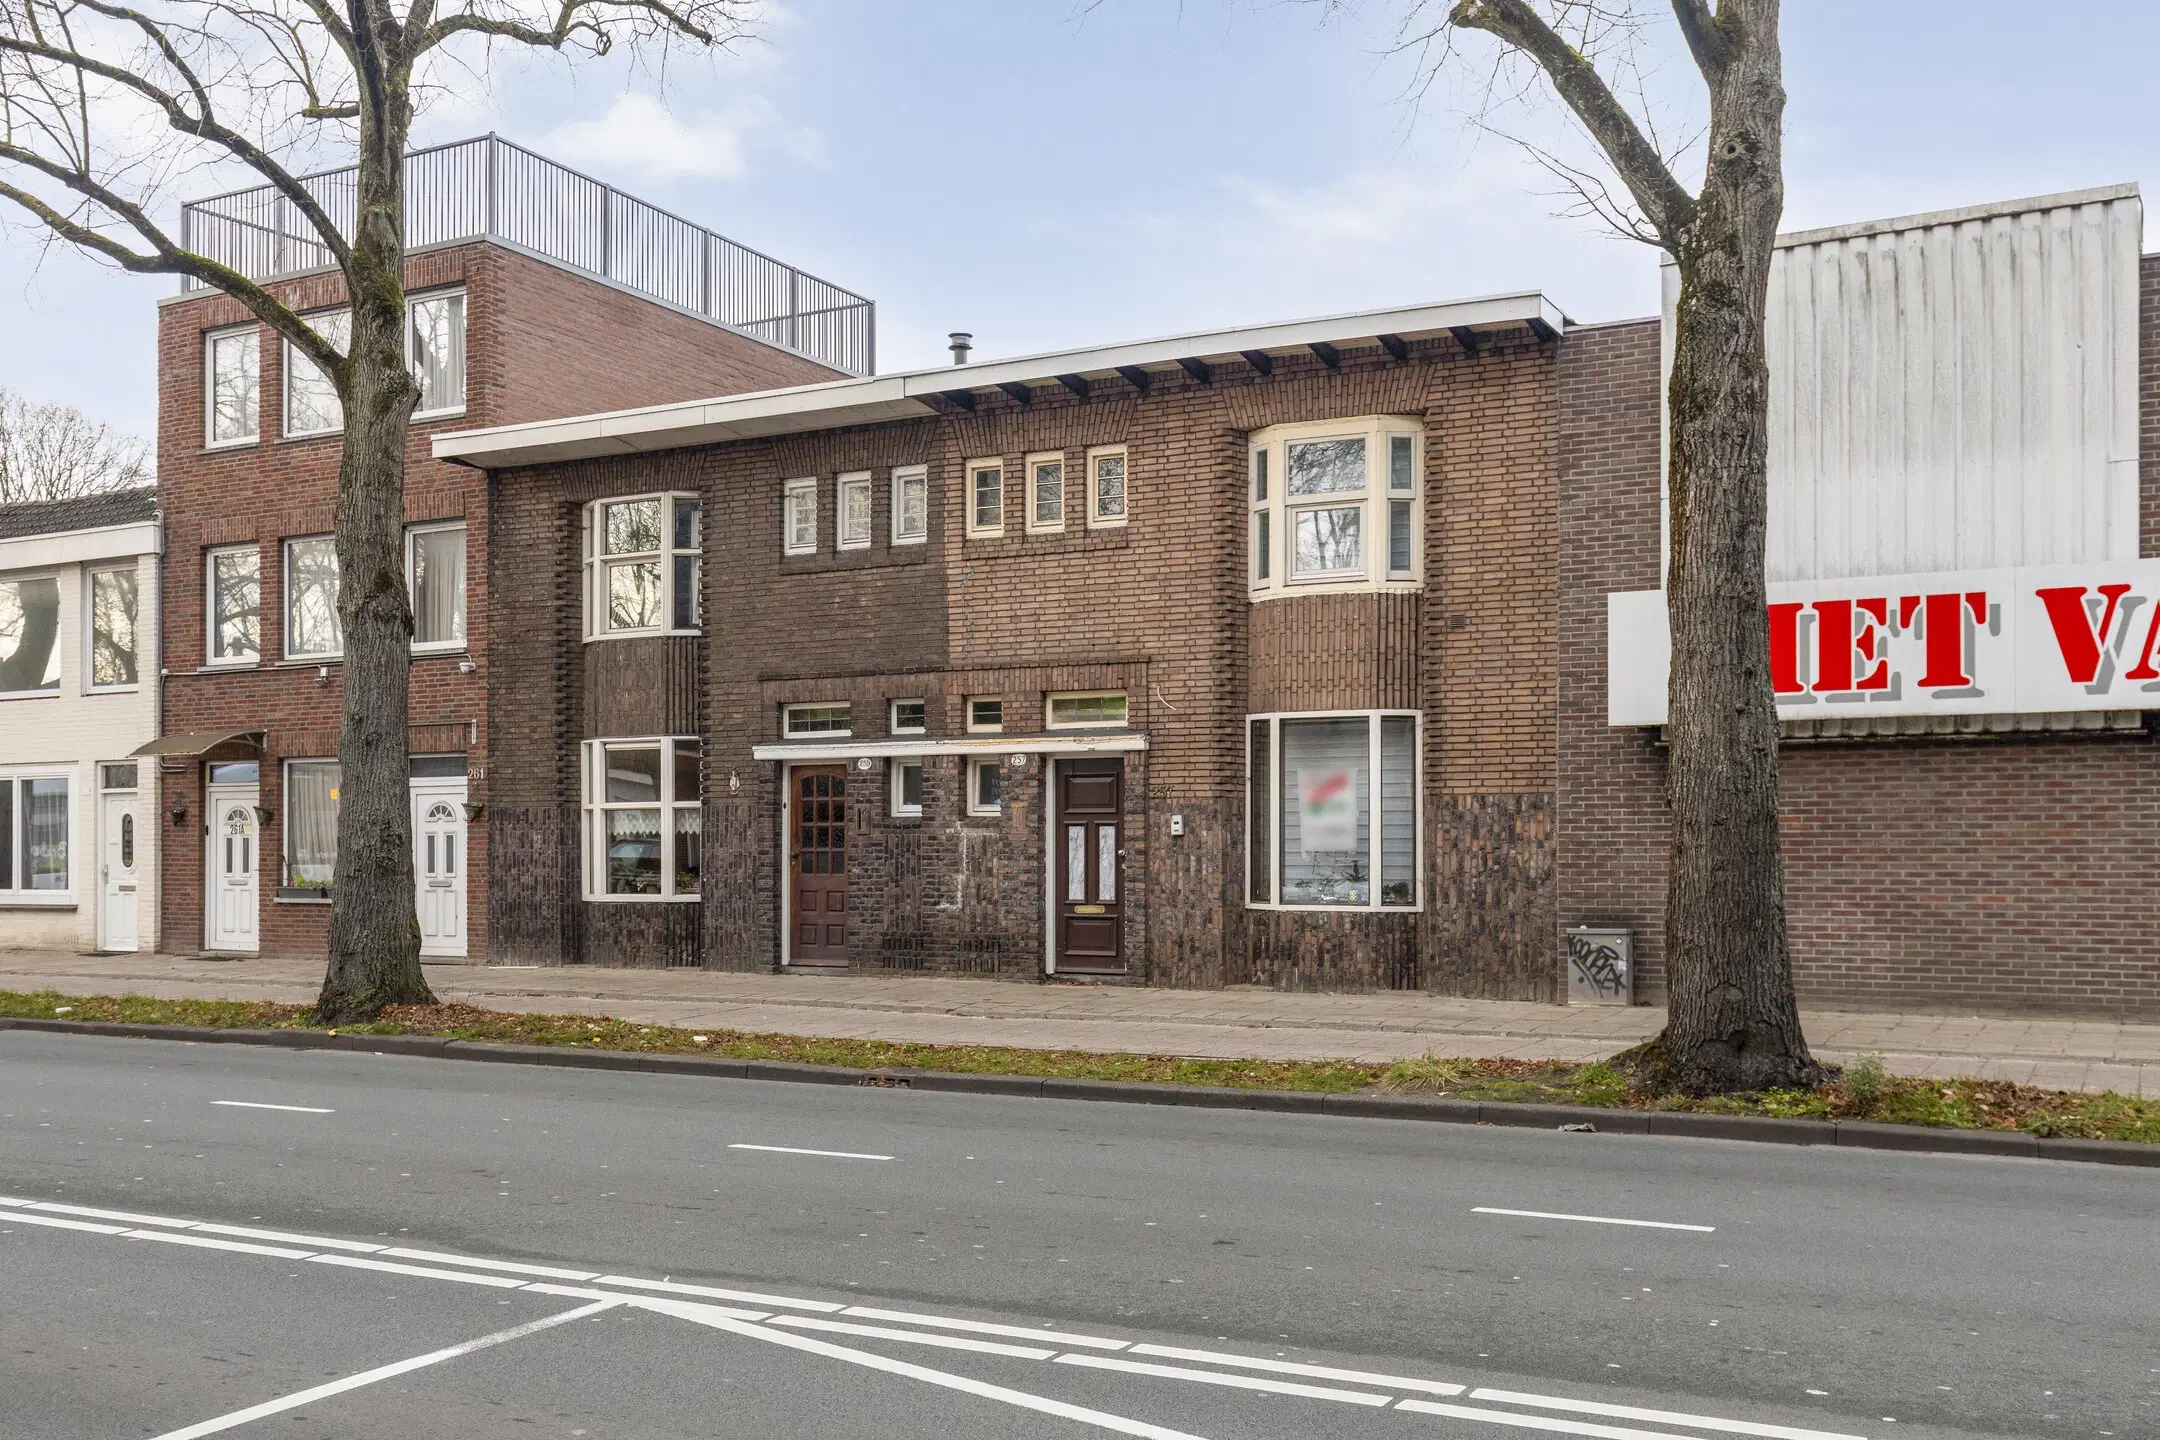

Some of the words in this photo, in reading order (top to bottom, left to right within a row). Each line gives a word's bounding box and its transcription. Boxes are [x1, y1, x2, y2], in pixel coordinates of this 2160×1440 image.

[1767, 591, 1999, 704] IET
[1012, 755, 1026, 764] 257
[467, 767, 484, 780] 261
[230, 824, 245, 835] 261A
